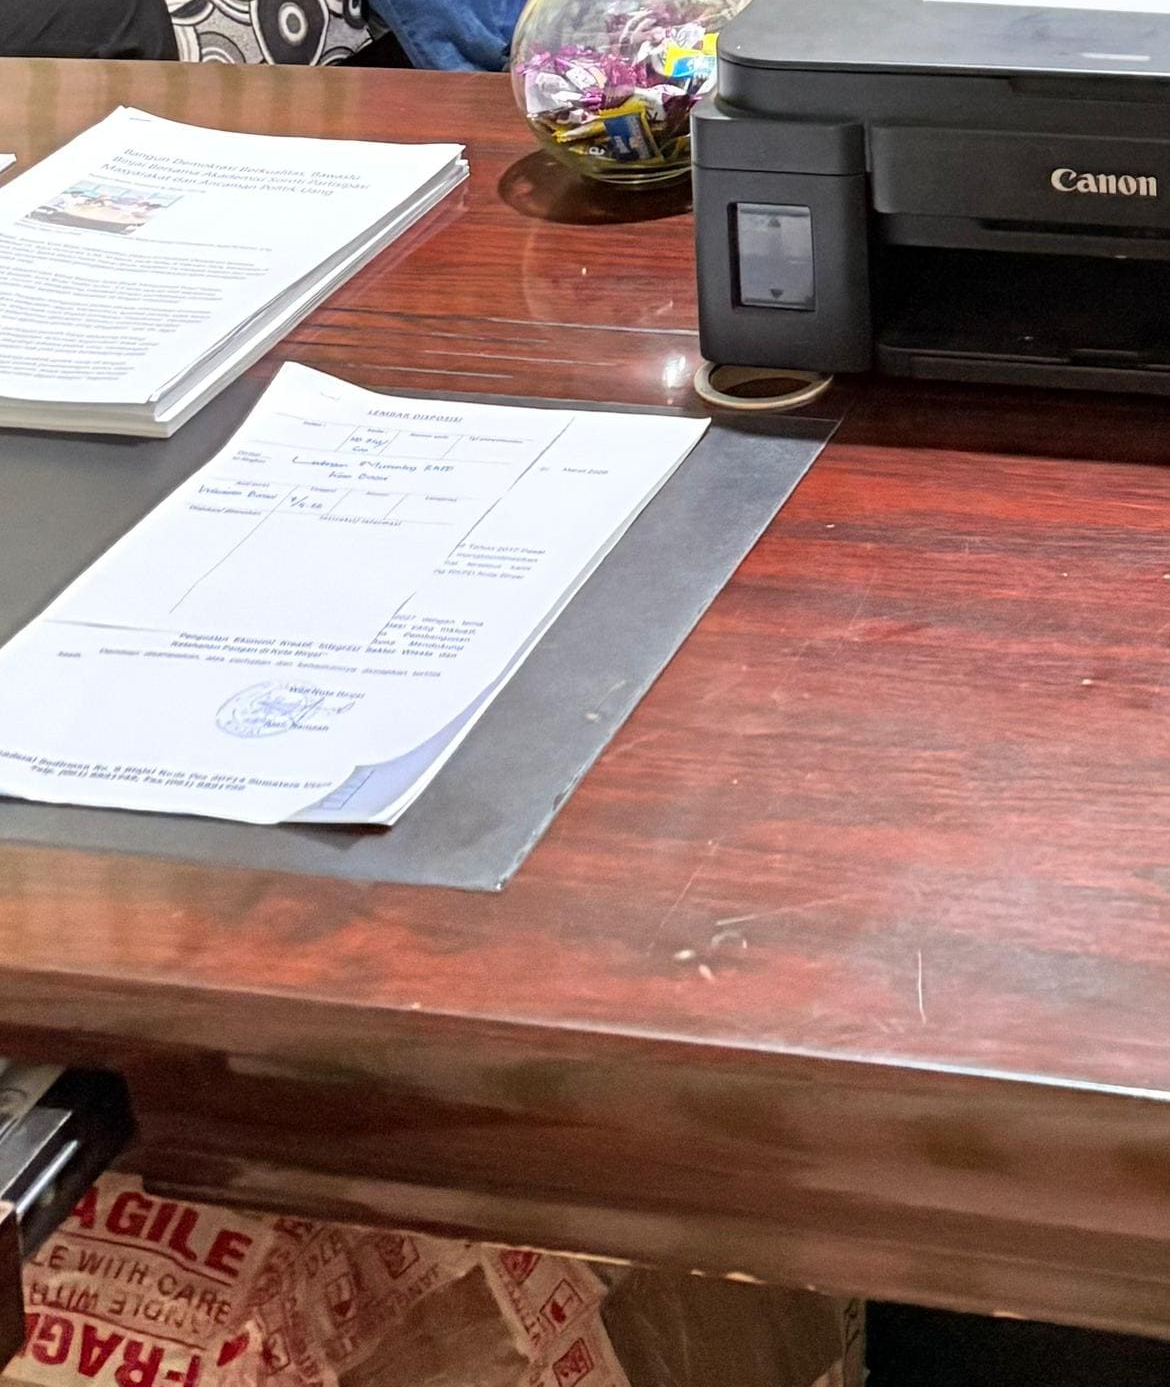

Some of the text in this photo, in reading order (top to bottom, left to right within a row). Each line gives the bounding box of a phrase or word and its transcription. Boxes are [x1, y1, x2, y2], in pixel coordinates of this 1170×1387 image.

[1050, 167, 1157, 199] Canon
[78, 1248, 149, 1286] WITH
[157, 1273, 233, 1325] CARE
